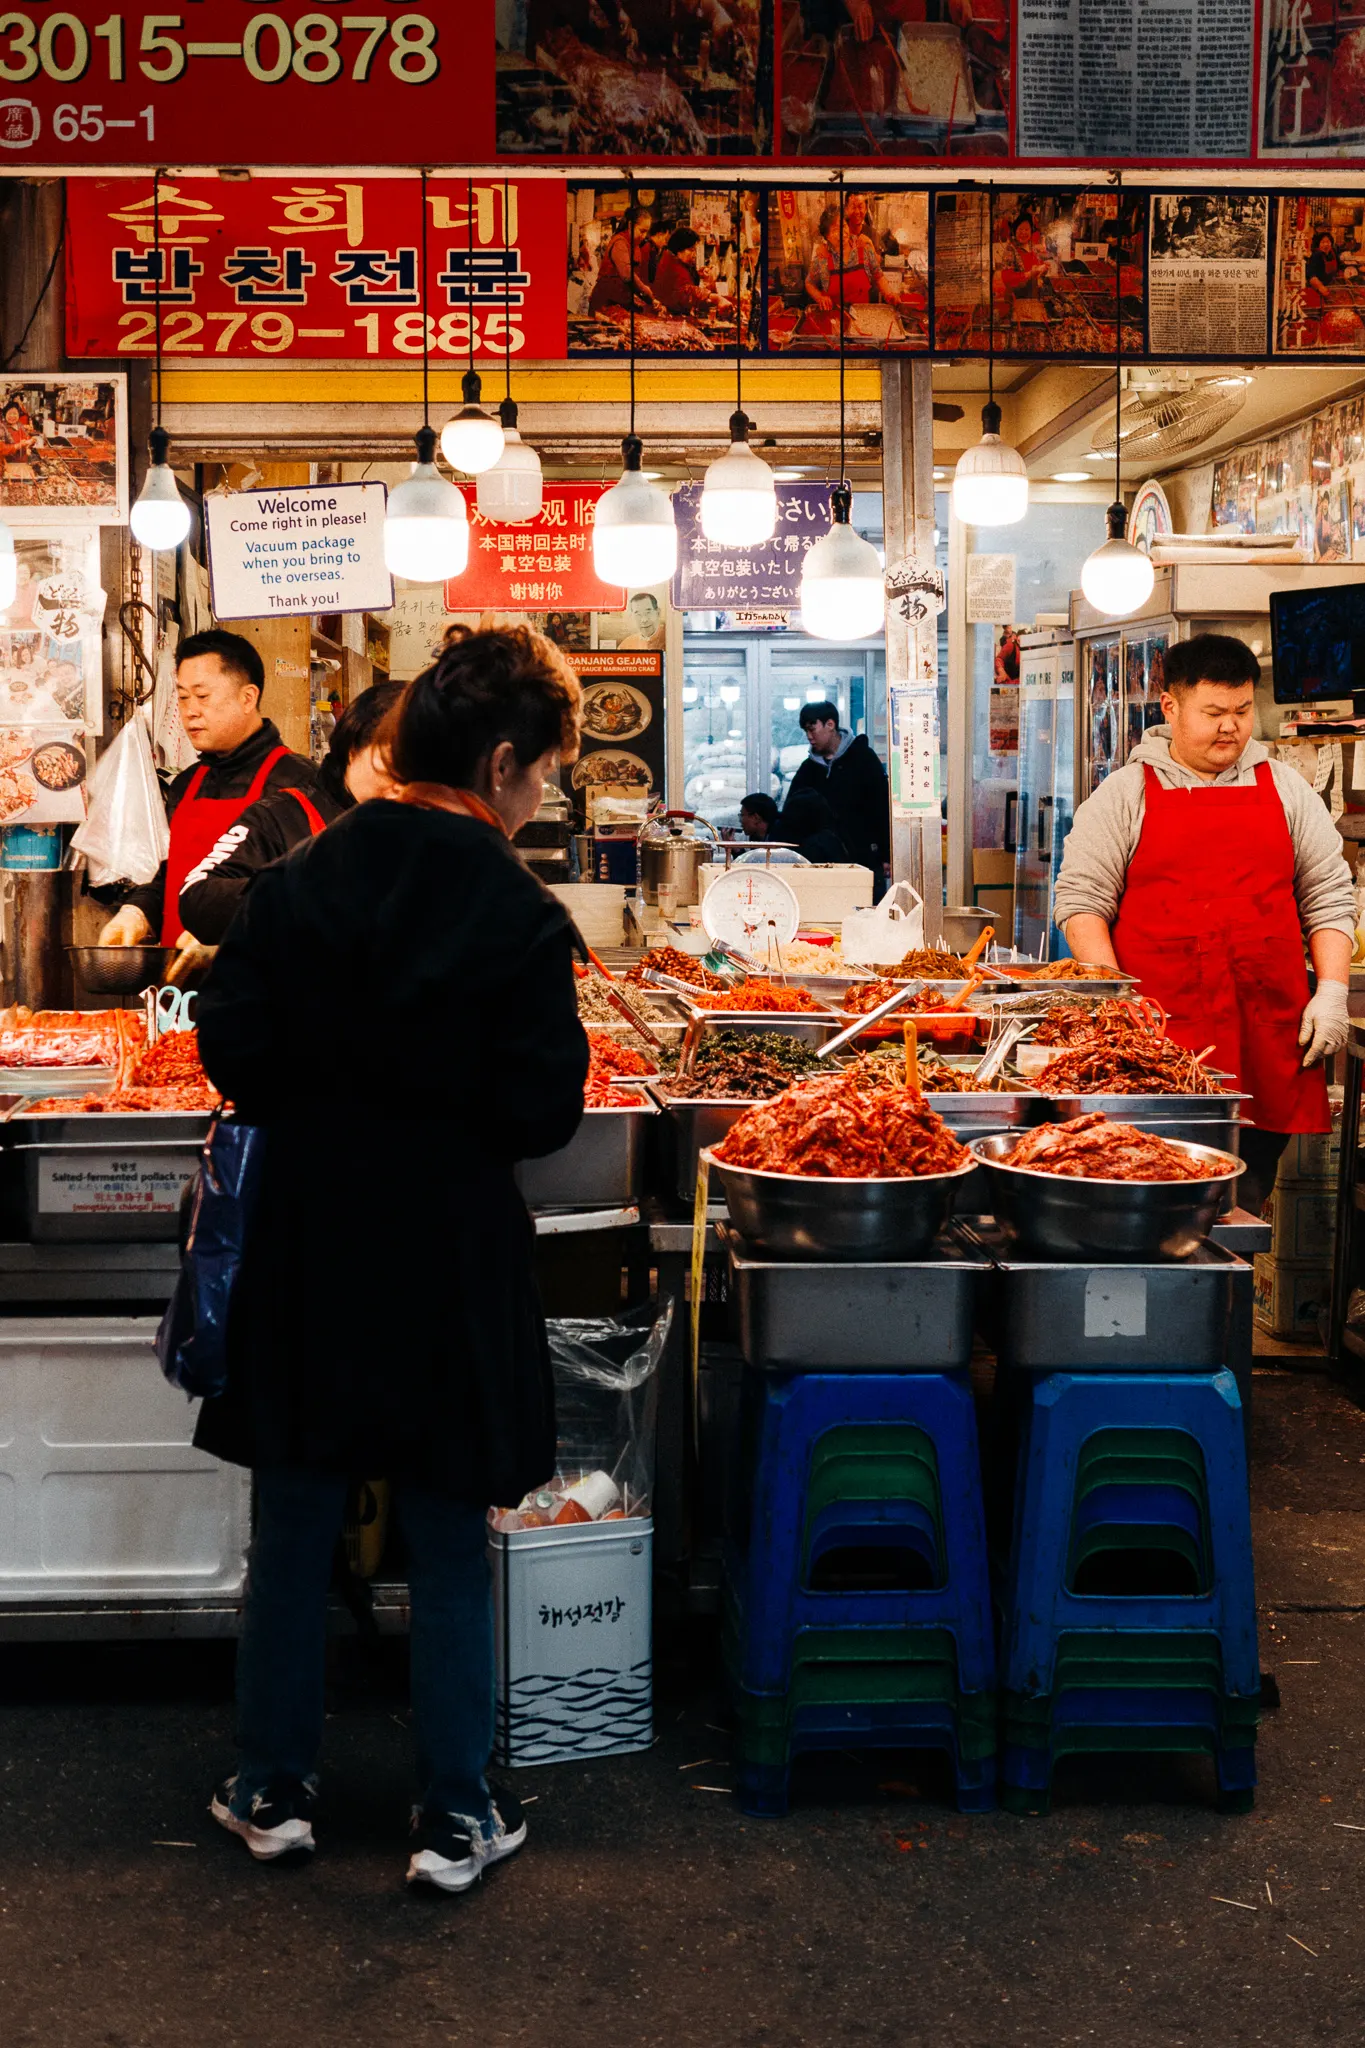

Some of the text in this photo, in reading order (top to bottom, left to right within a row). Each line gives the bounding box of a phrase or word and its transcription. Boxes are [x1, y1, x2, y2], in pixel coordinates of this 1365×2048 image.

[112, 247, 531, 306] 반찬전문
[117, 311, 526, 355] 2279-1885
[257, 497, 338, 515] Welcome
[230, 512, 367, 532] Come right in please!
[245, 536, 355, 553] Vacuum package
[243, 552, 361, 569] when you bring to
[500, 554, 572, 573] 真空包装
[261, 570, 345, 585] the overseas.
[268, 592, 340, 608] Thank you!
[509, 582, 563, 601] 谢谢你
[567, 656, 657, 666] GANJANG GEJANG
[52, 1172, 138, 1182] Salted-fermented
